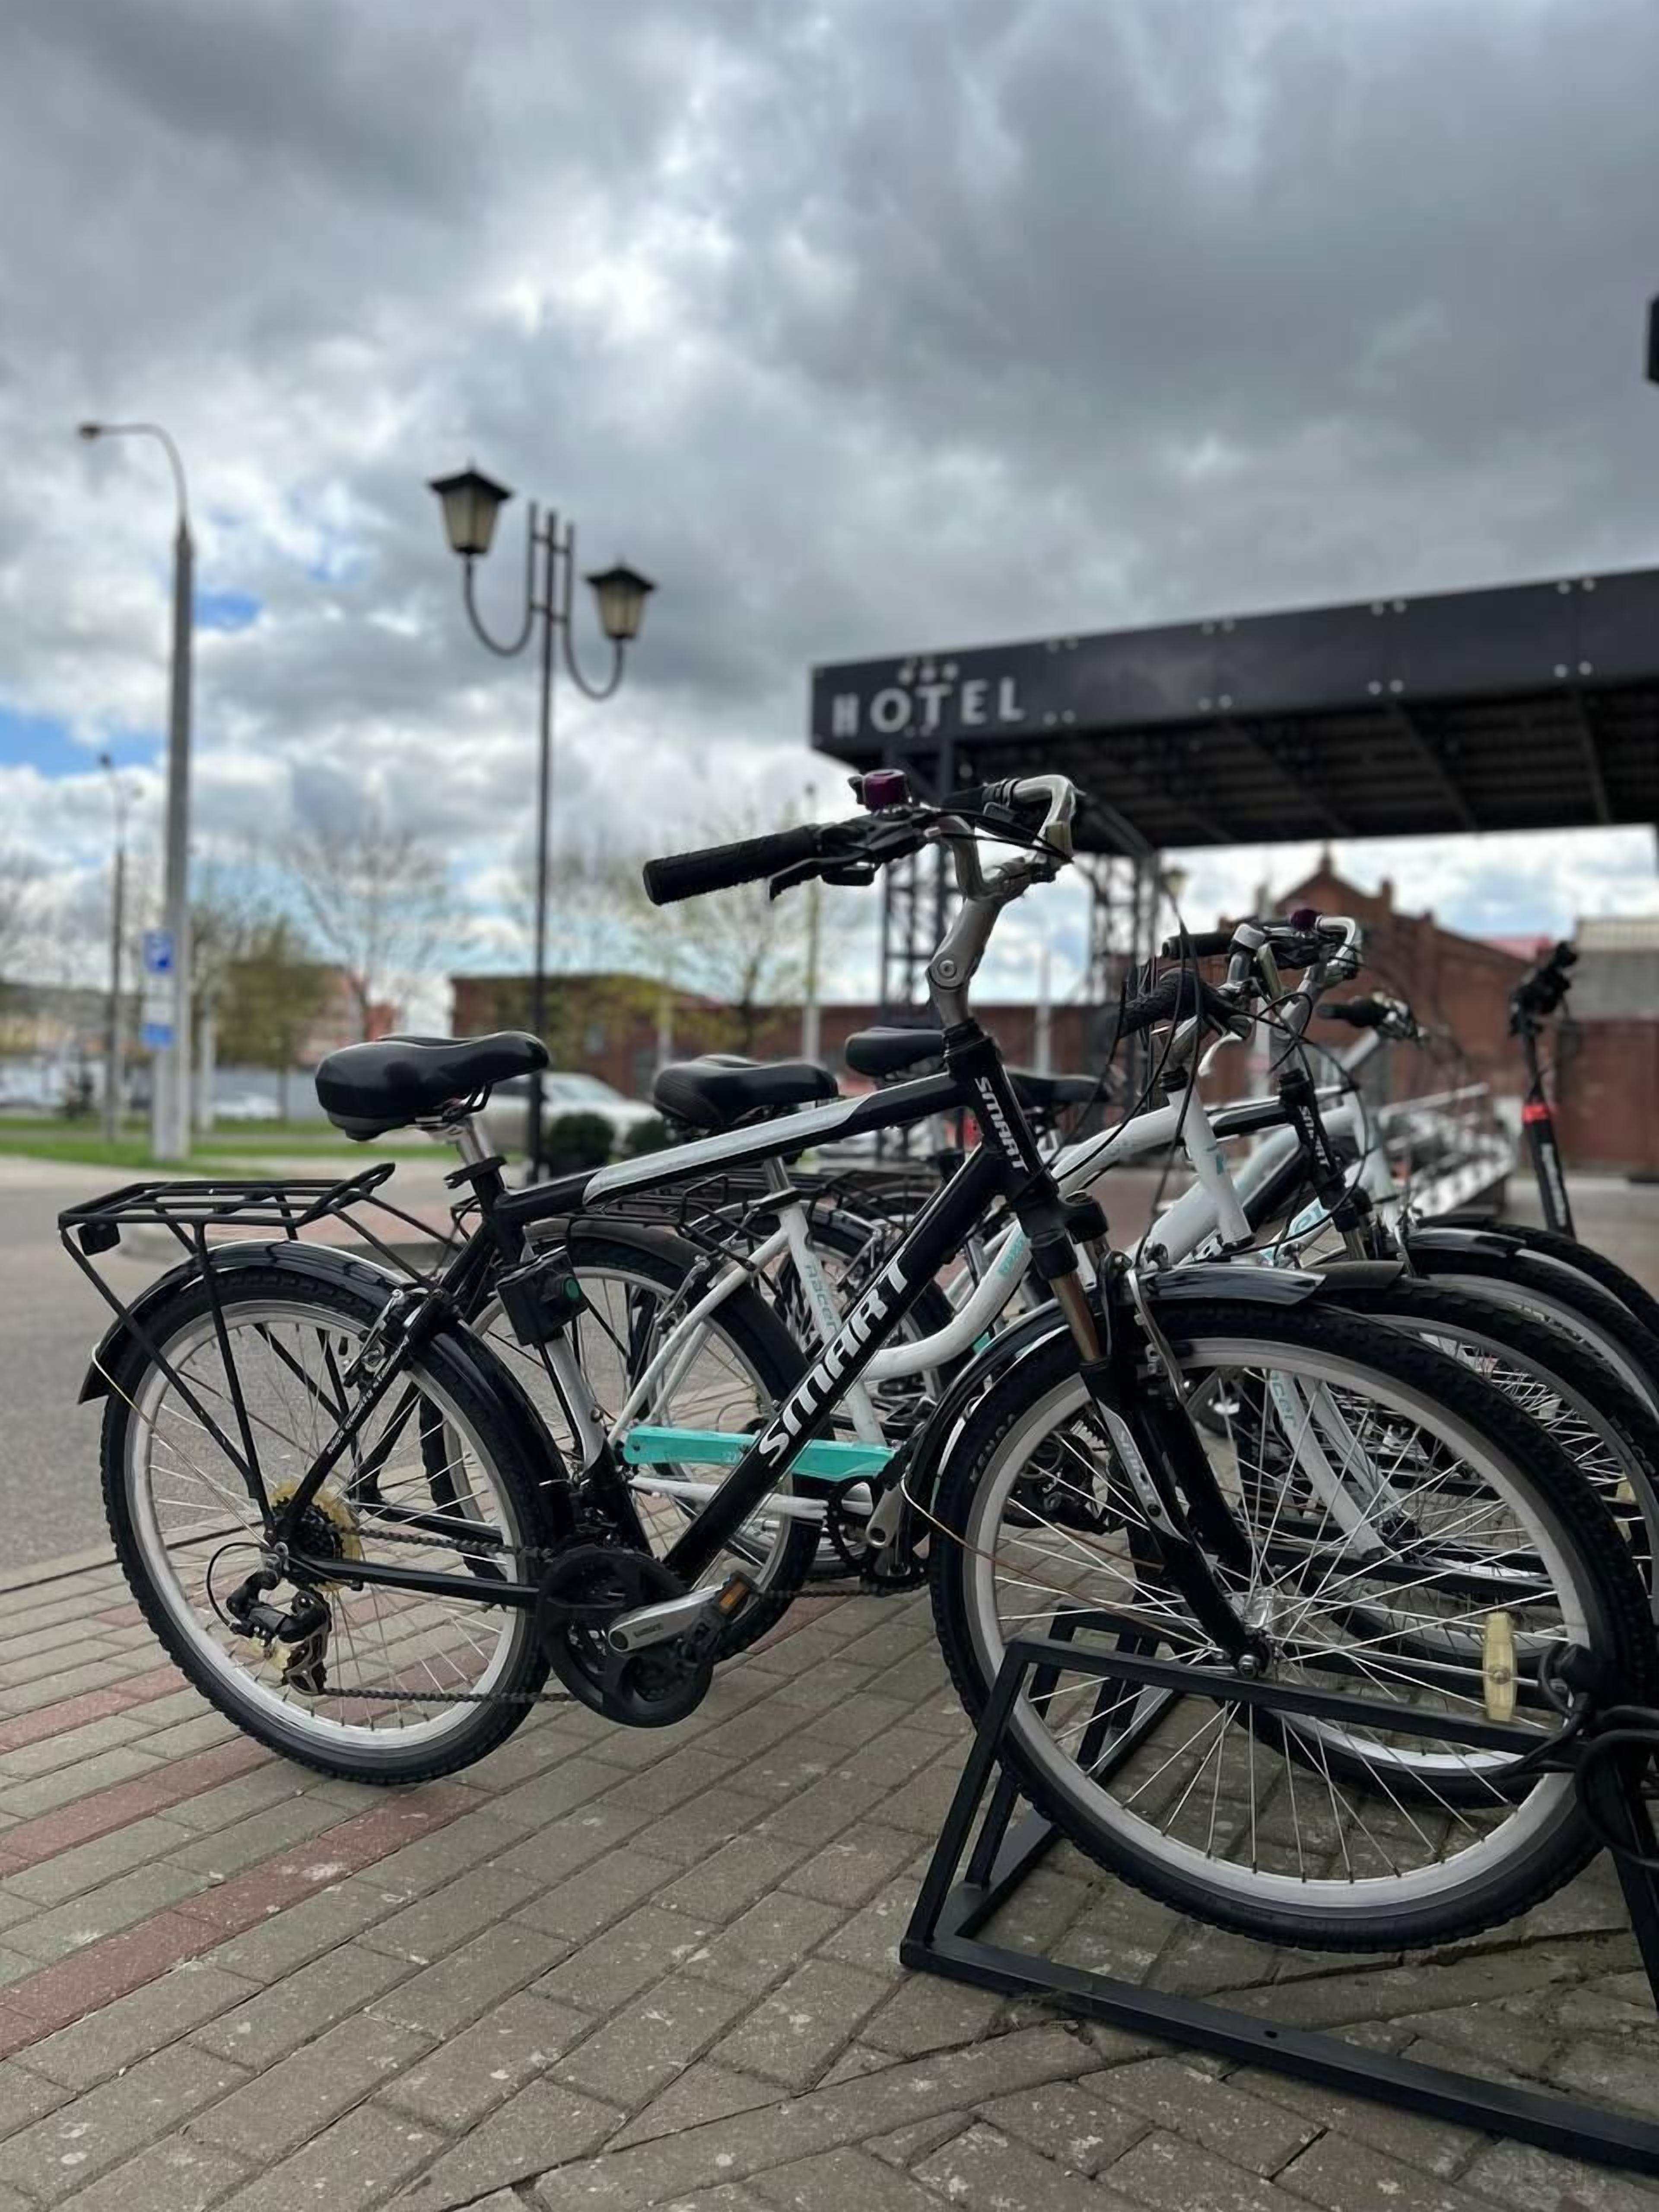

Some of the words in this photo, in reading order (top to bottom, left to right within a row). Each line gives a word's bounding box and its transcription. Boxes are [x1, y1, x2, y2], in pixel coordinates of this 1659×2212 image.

[832, 677, 1024, 737] HOTEL
[975, 1077, 1030, 1172] SMART
[759, 1246, 907, 1467] SMART
